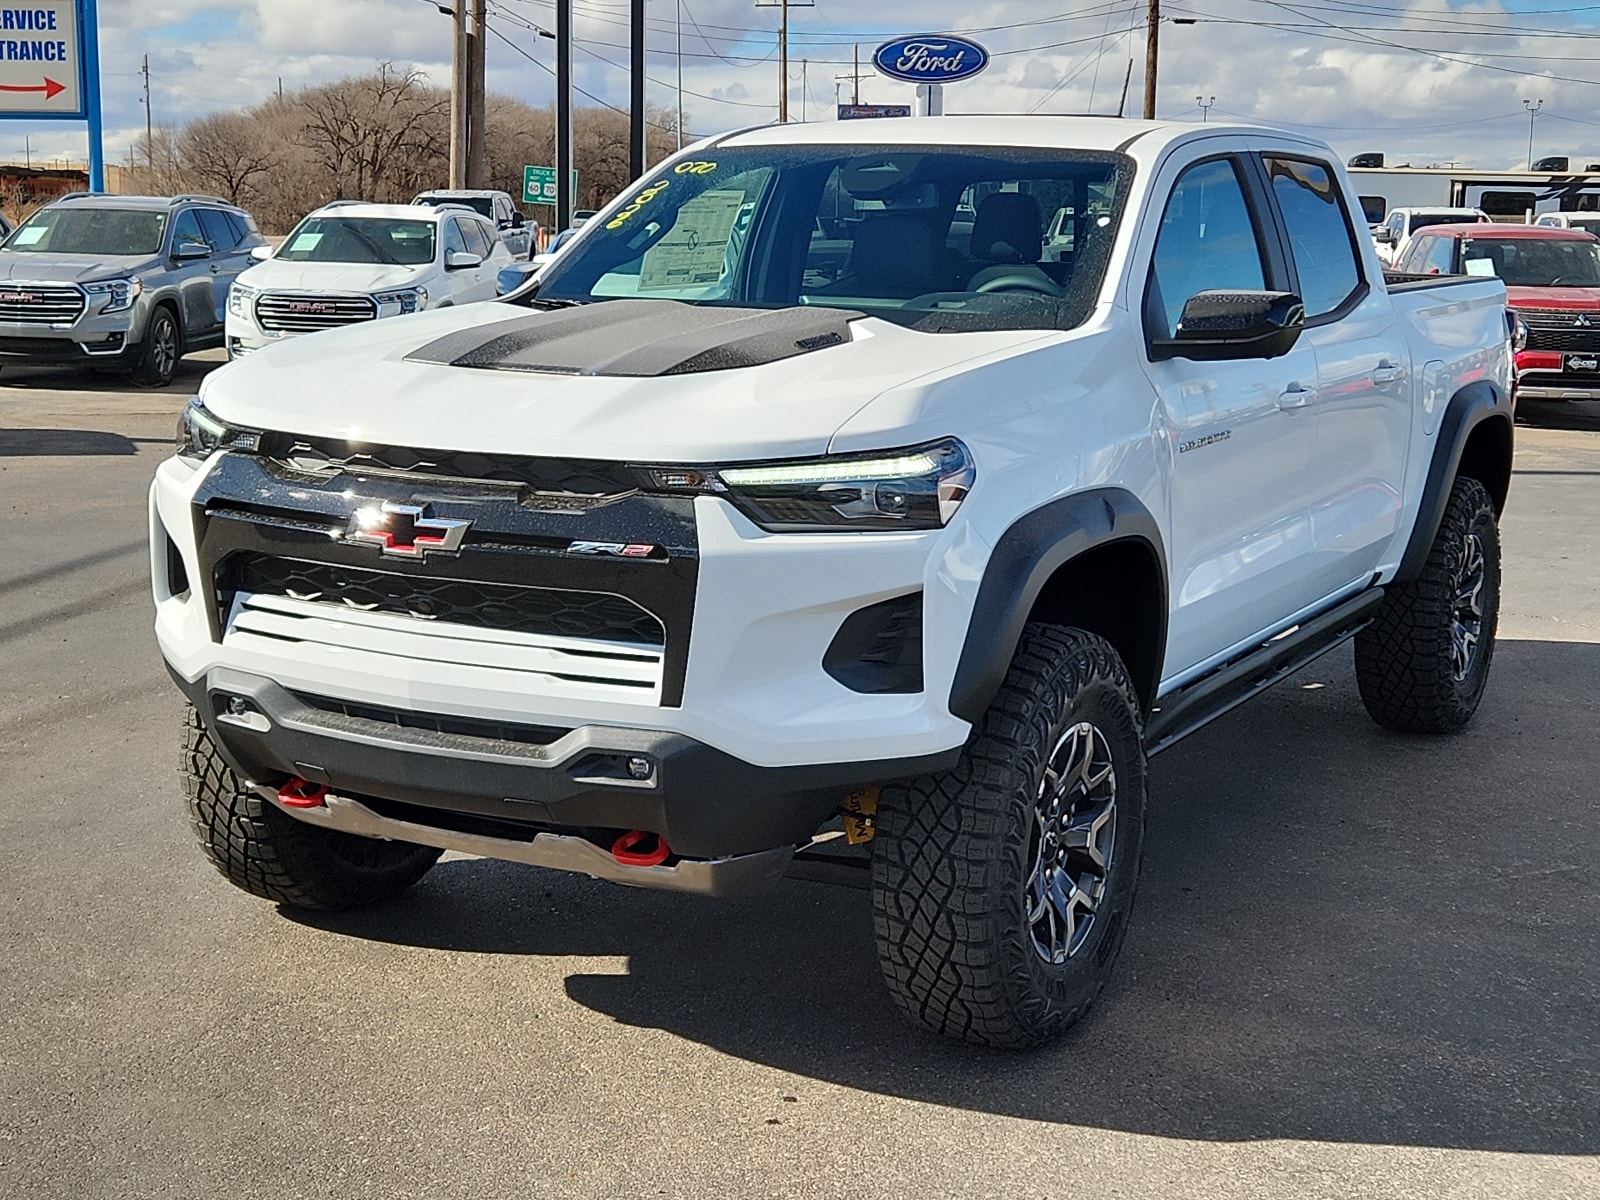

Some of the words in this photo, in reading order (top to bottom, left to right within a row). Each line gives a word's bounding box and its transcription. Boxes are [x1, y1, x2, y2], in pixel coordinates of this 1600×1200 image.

[0, 9, 57, 30] RVICE
[896, 43, 965, 72] Ford
[674, 161, 717, 174] 070
[529, 184, 539, 192] 60
[545, 185, 555, 194] 70
[289, 301, 336, 313] GMC
[566, 540, 655, 558] ZR2
